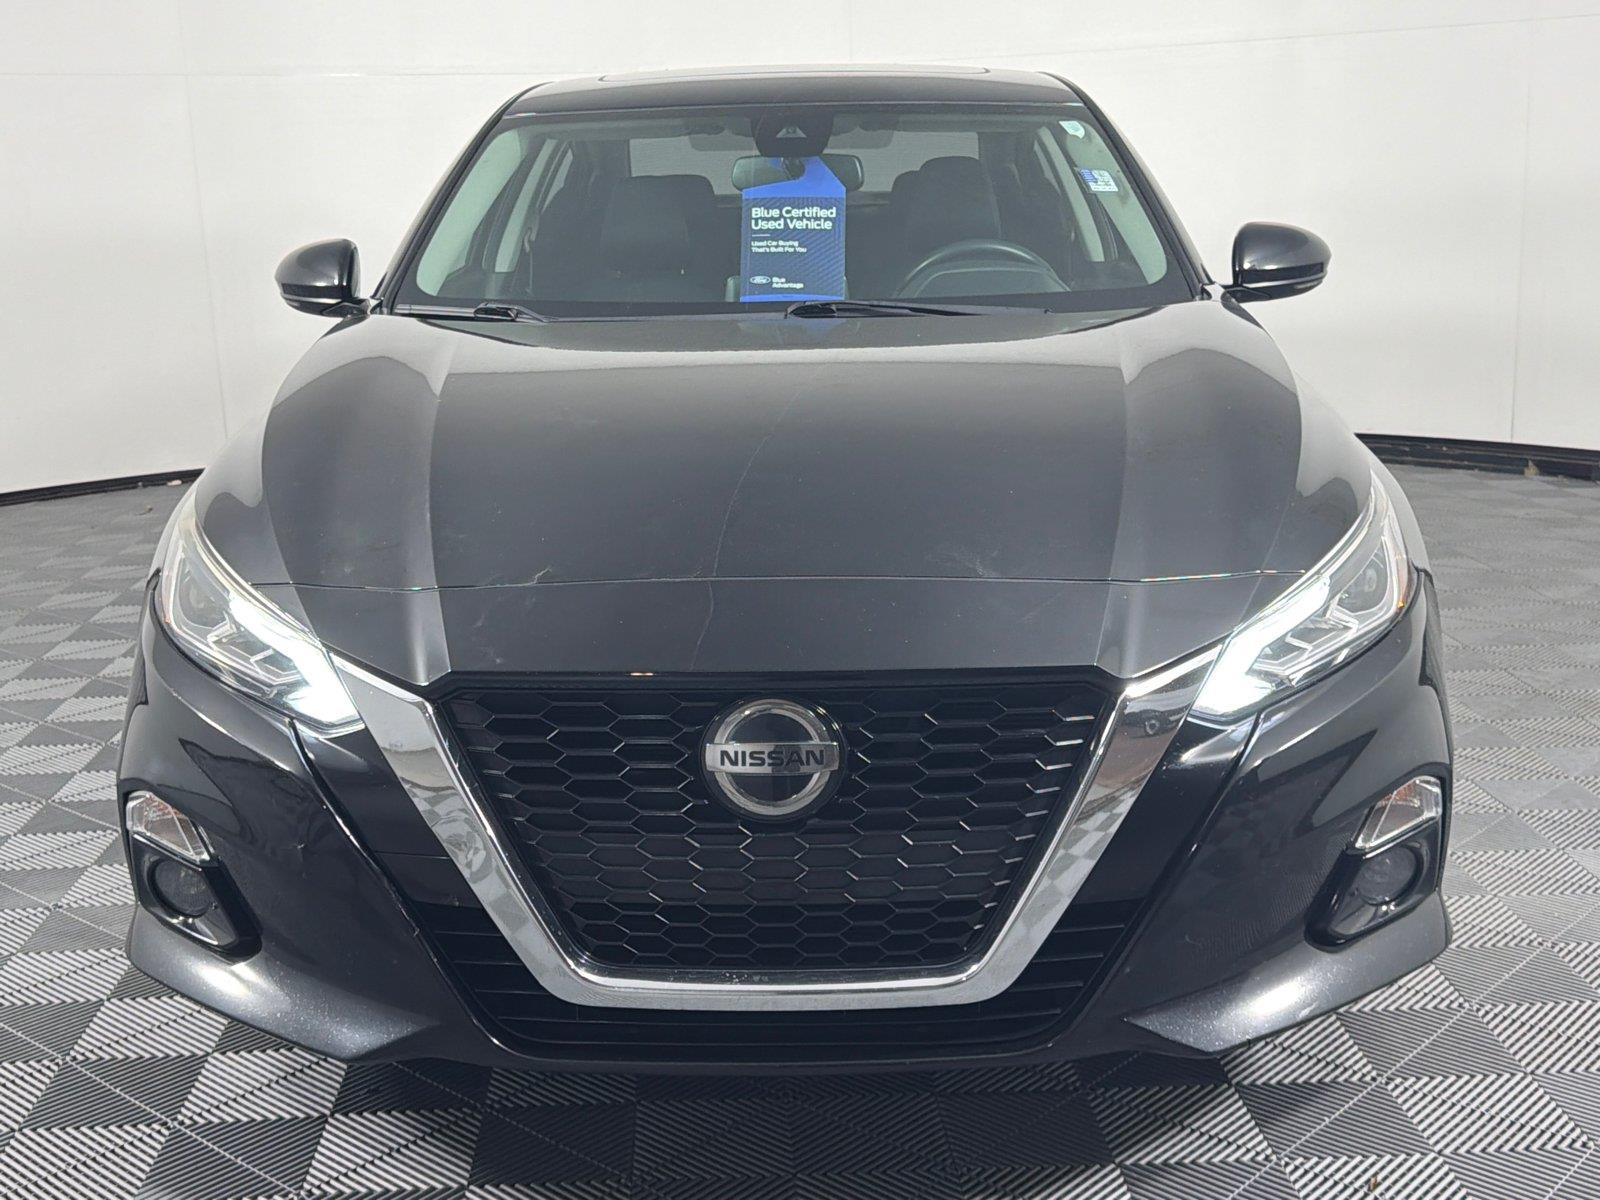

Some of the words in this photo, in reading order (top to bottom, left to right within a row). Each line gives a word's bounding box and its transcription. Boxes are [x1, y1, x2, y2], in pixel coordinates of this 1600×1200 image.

[751, 206, 780, 218] Blue
[782, 206, 837, 218] Certified
[751, 218, 784, 230] Used
[786, 218, 833, 230] Vehicle
[720, 750, 825, 766] NISSAN
